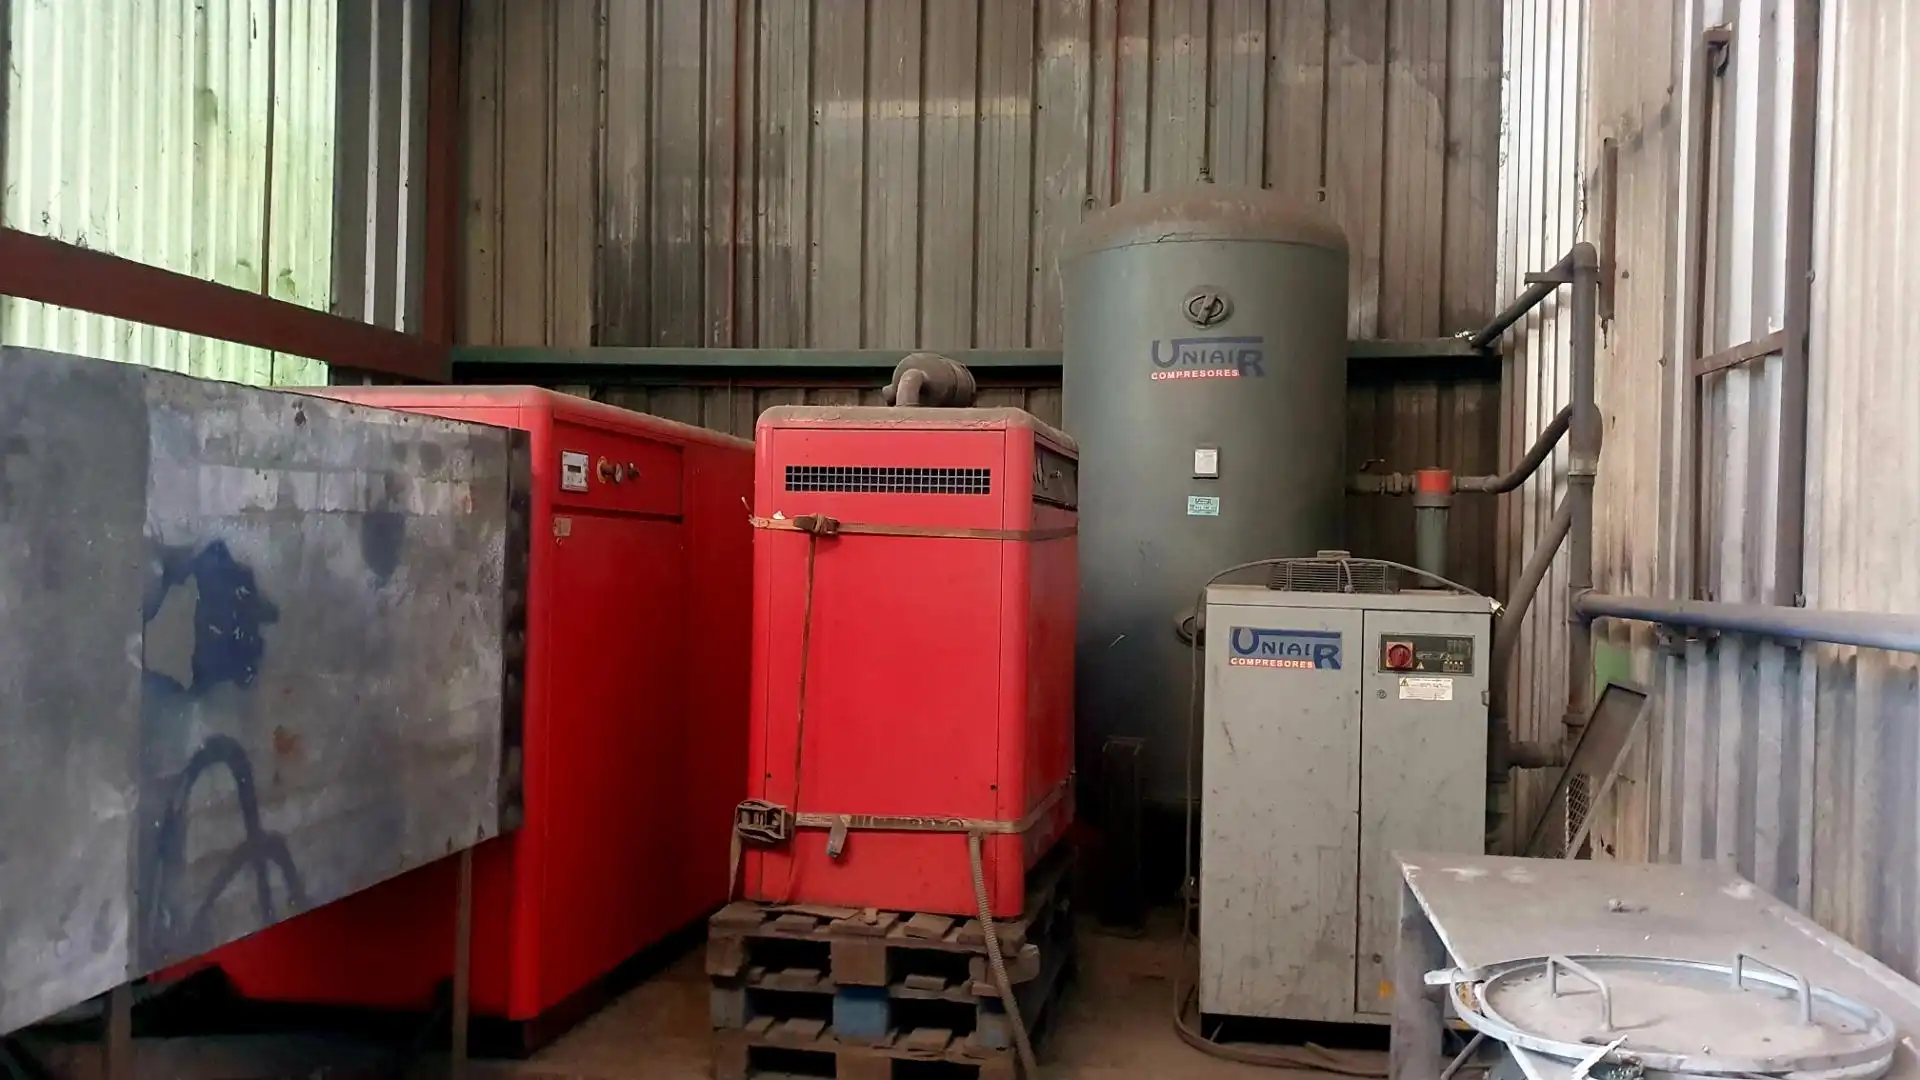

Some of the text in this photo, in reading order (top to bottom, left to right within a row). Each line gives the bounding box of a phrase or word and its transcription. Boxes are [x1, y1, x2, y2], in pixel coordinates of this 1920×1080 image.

[1152, 336, 1264, 377] UNIAIR
[1151, 369, 1240, 380] COMPRESORES
[1232, 628, 1341, 669] UNIAIR
[1230, 658, 1314, 669] COMPRESORES
